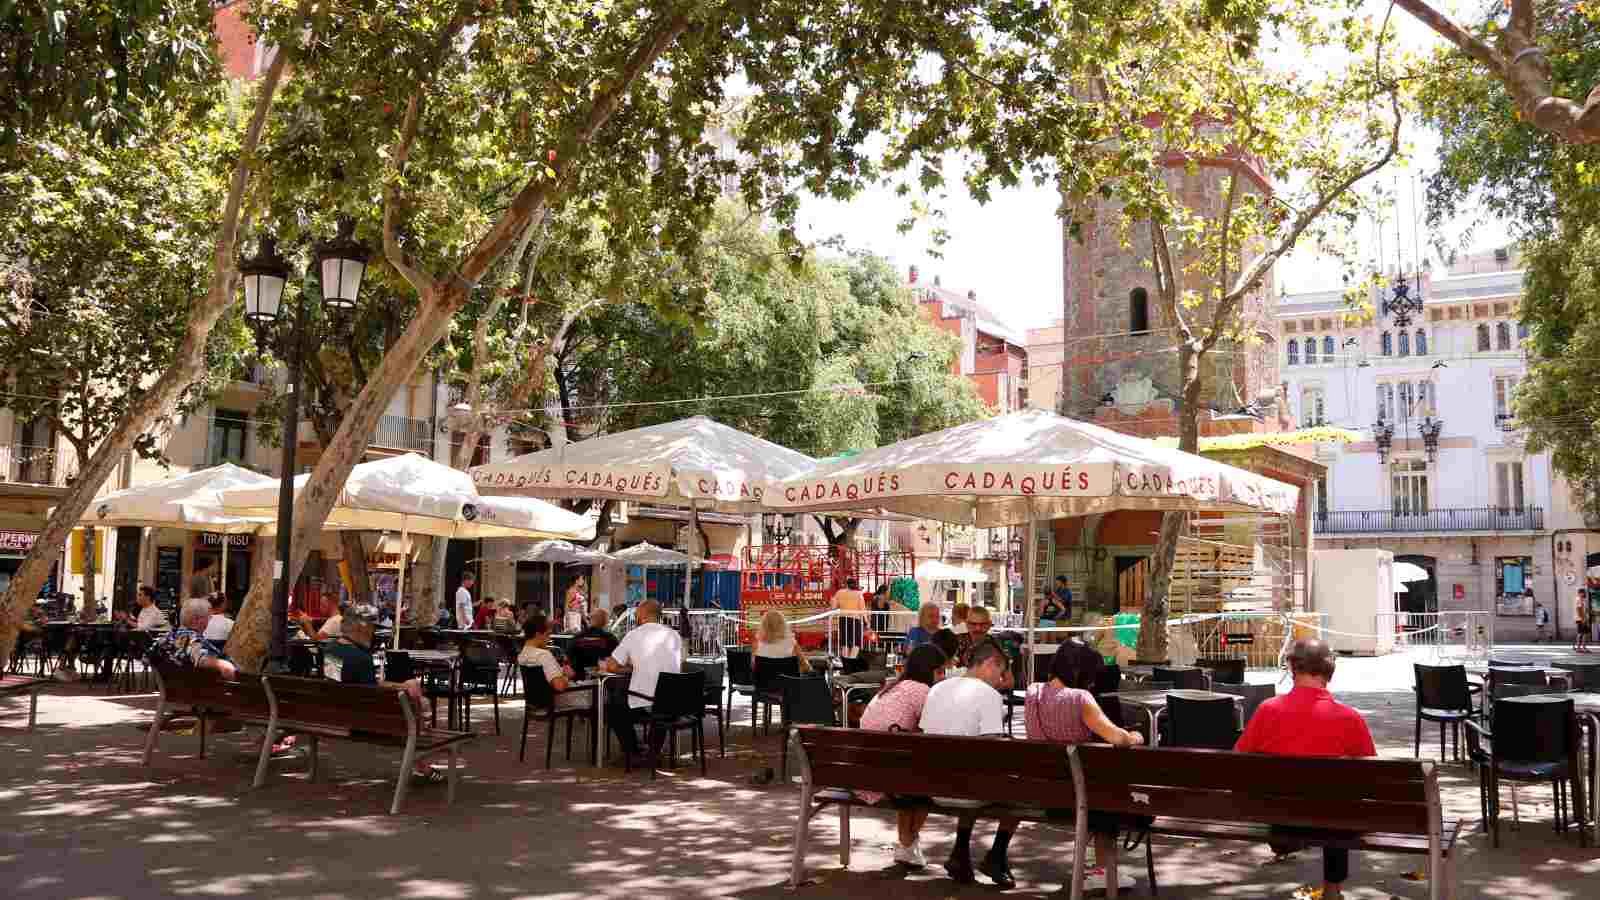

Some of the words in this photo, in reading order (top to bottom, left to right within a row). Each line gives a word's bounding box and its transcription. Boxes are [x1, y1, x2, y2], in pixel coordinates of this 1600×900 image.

[566, 470, 661, 492] CADAQUÉS
[785, 472, 899, 502] CADAQUÉS
[944, 466, 1089, 494] CADAQUÉS
